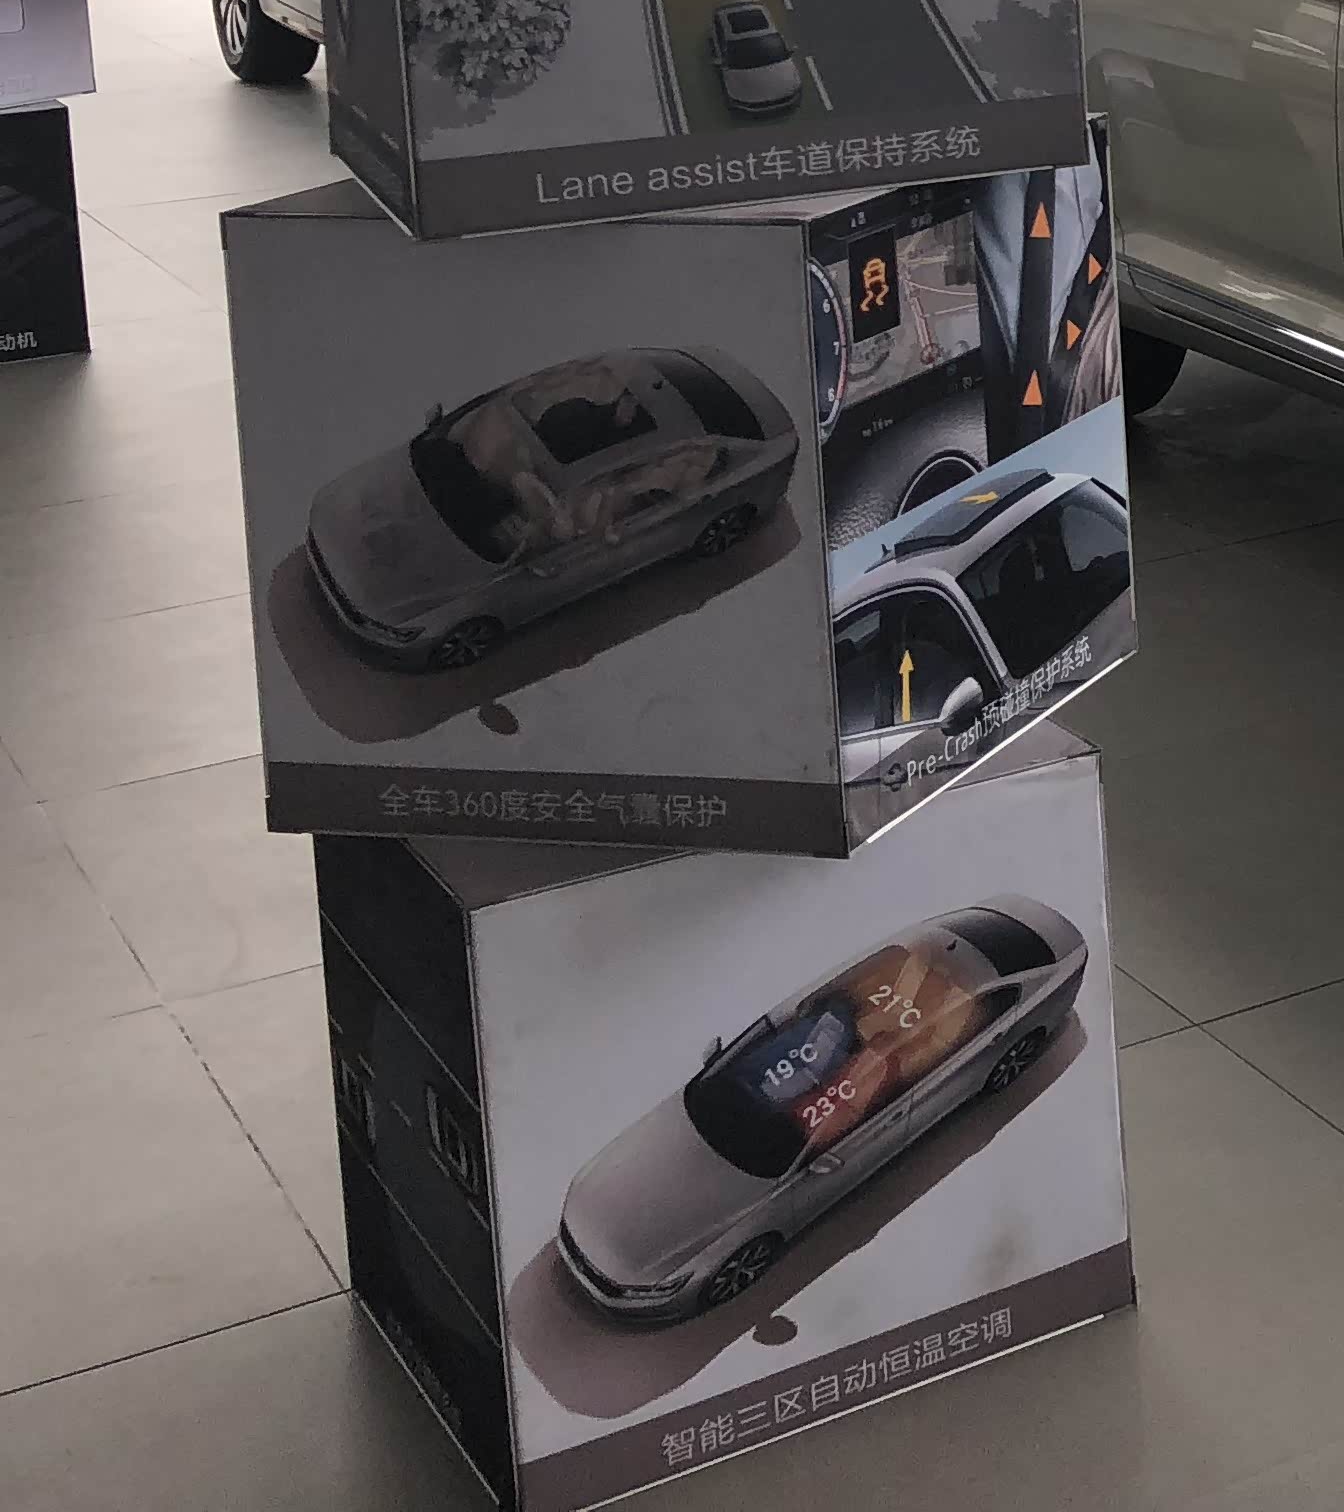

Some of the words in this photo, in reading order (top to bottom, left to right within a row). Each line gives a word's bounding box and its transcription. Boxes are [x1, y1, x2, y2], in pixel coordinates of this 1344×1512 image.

[536, 167, 634, 204] Lane
[647, 125, 982, 191] assist车道保持系统
[377, 783, 729, 830] 全车360度安全气囊保护
[660, 1307, 1013, 1468] 智能三区自动恒温空调
